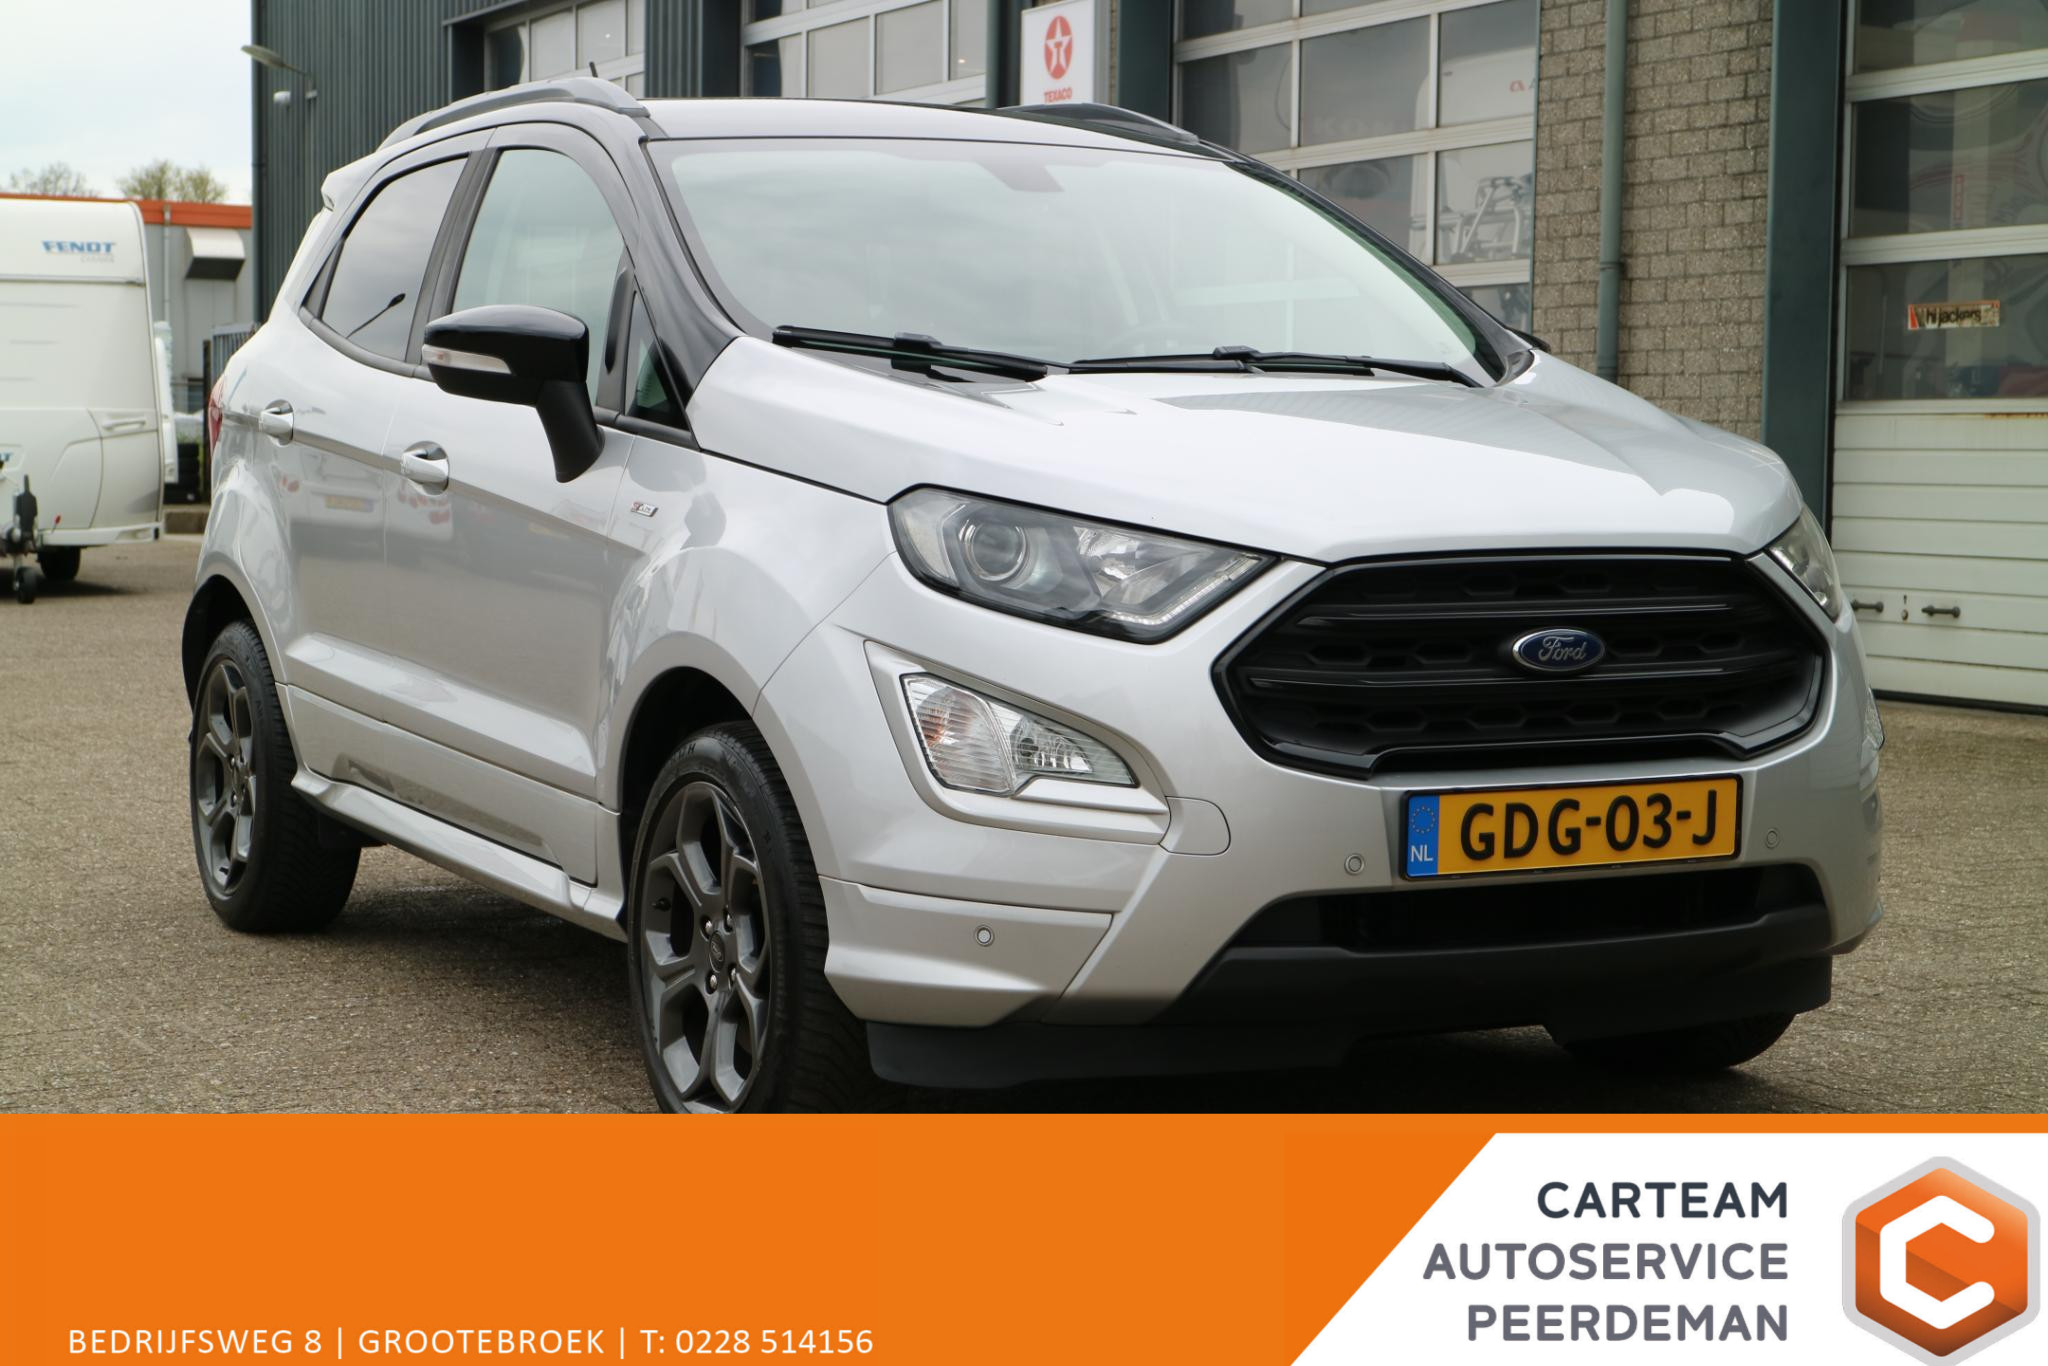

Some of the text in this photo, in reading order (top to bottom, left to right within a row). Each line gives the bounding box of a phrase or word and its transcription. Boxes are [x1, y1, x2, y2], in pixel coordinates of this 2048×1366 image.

[1044, 87, 1072, 104] TEXACO
[42, 240, 116, 254] FENDT
[1538, 636, 1588, 661] Ford
[1460, 789, 1717, 861] GDG-03-J
[1411, 845, 1433, 862] NL
